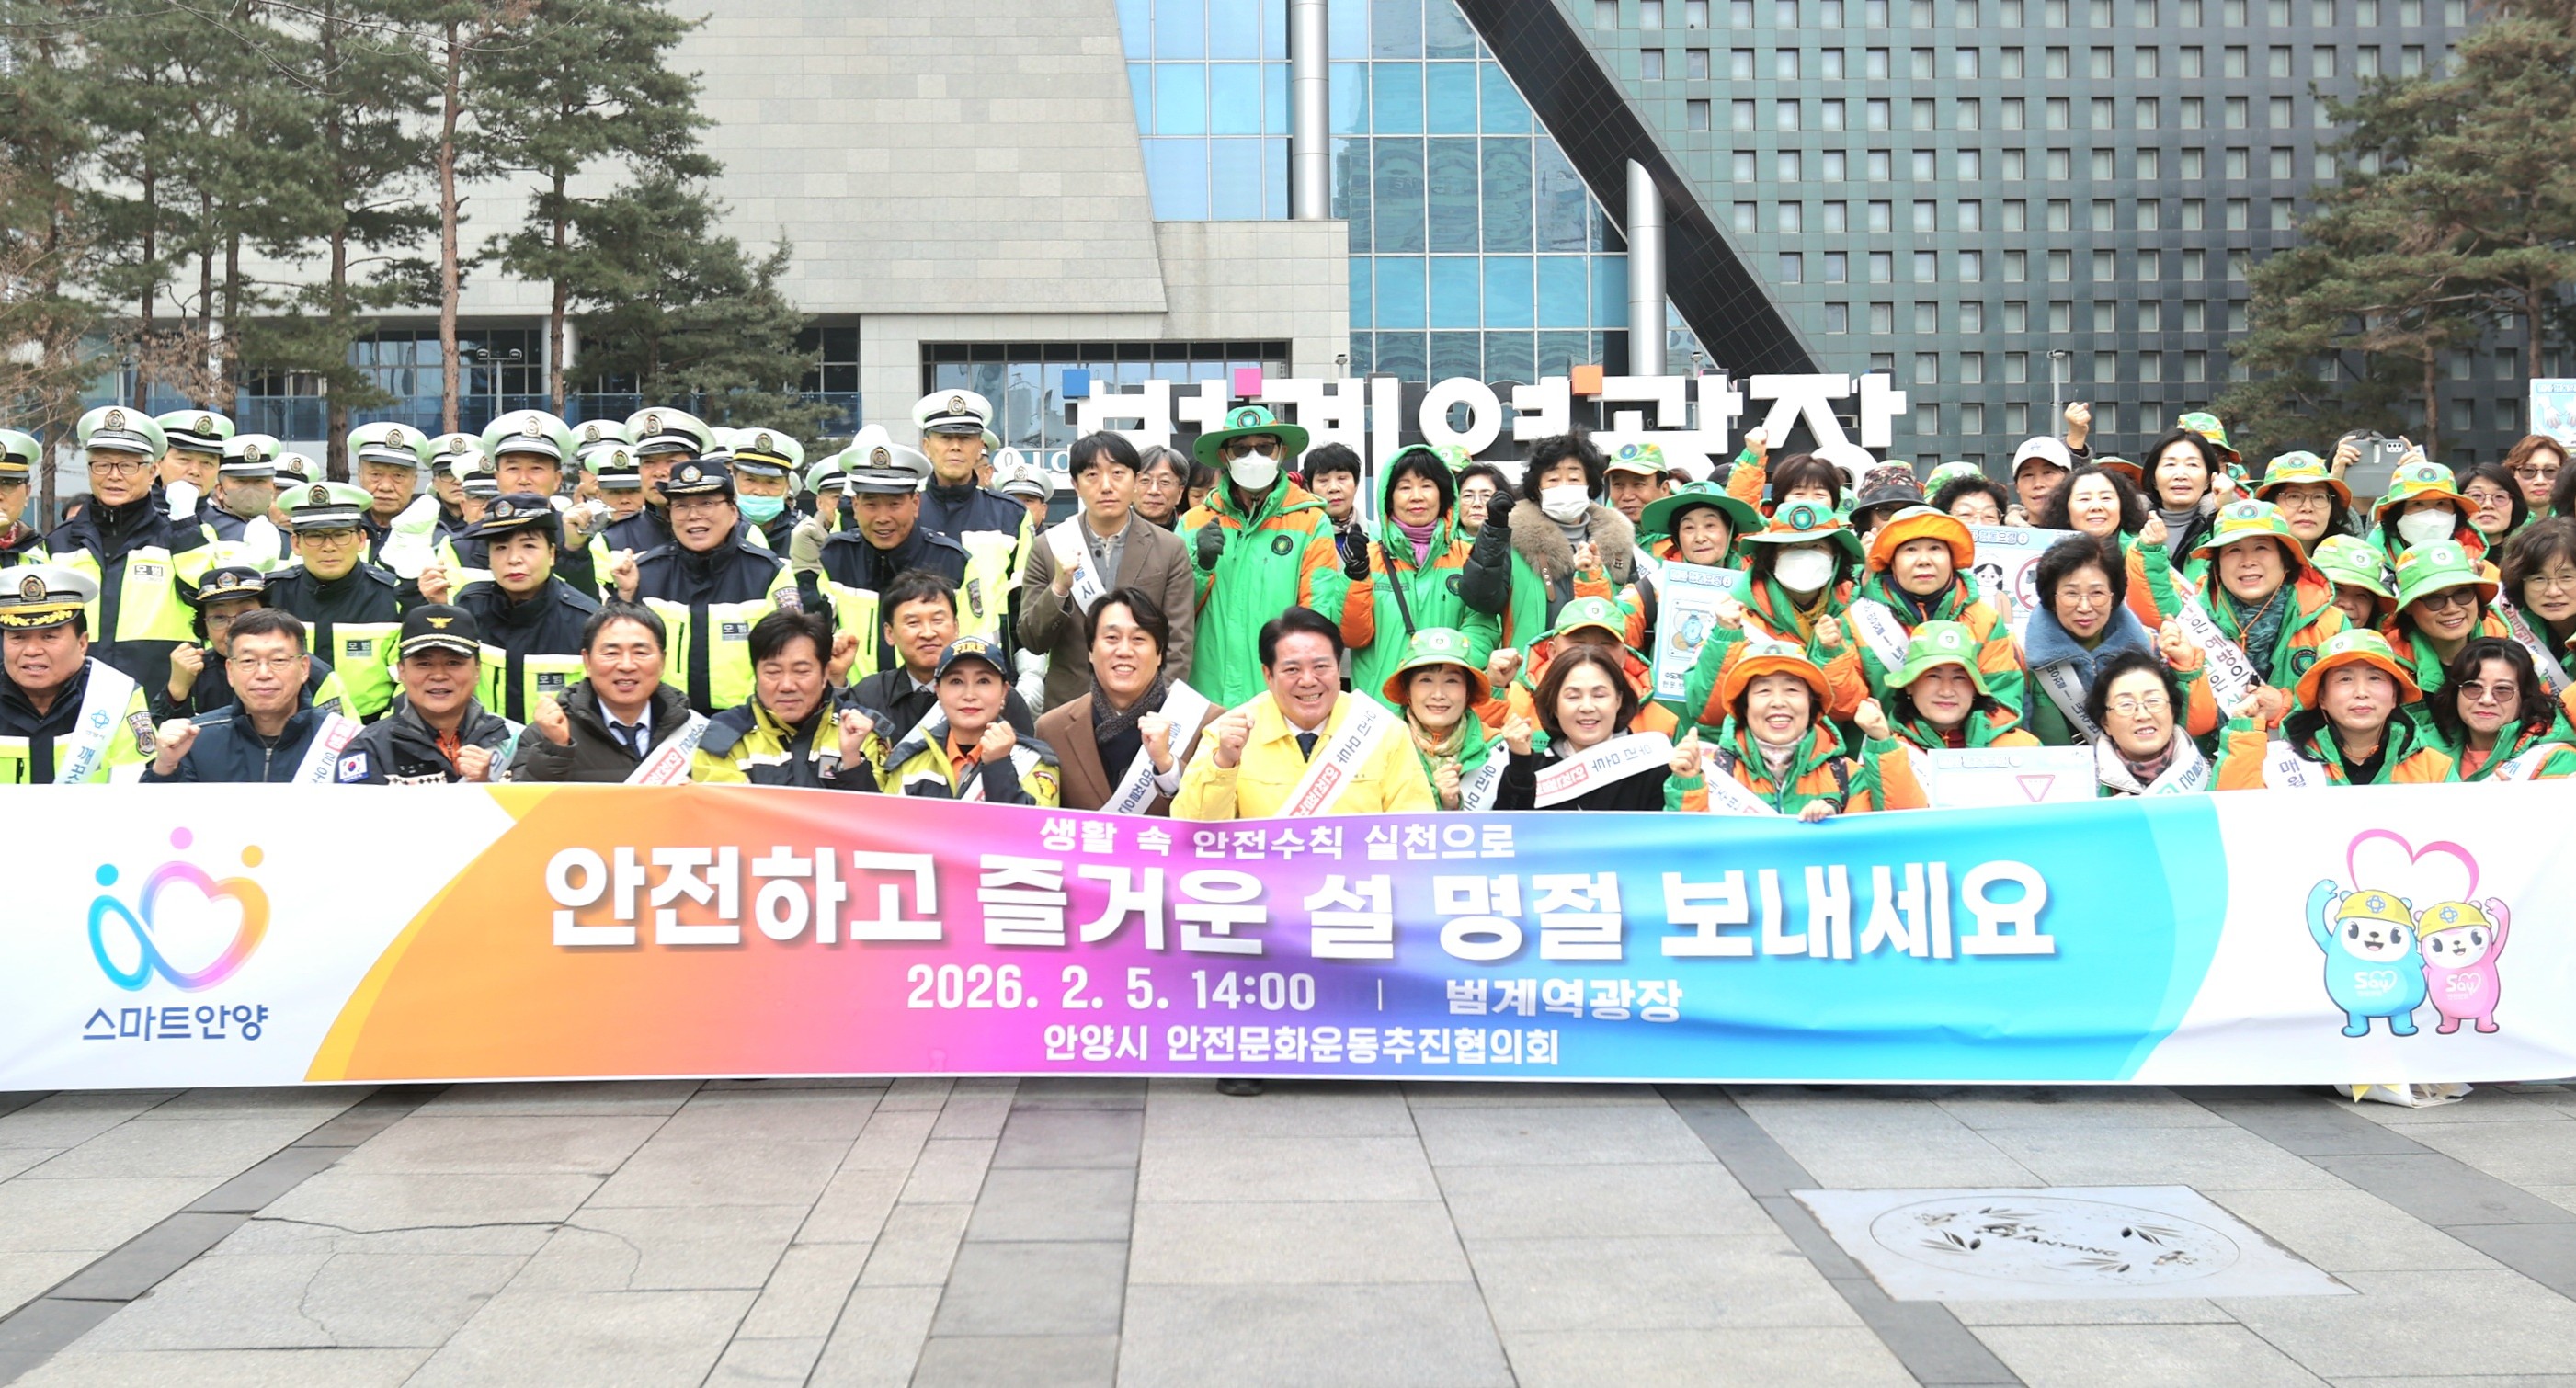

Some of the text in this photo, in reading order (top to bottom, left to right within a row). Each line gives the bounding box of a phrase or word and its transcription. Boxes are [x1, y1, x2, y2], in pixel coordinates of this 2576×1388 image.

[952, 641, 986, 656] FIRE
[64, 746, 95, 783] 깨끗
[1040, 816, 1516, 861] 생활 속 안전수칙 실천으로
[545, 844, 2055, 961] 안전하고 즐거운 설 명절 보내세요
[906, 963, 1683, 1023] 2026. 2. 5. 14:00 범계역광장
[83, 1004, 268, 1041] 스마트안양
[1043, 1023, 1559, 1066] 안양시 안전문화운동추진협의회
